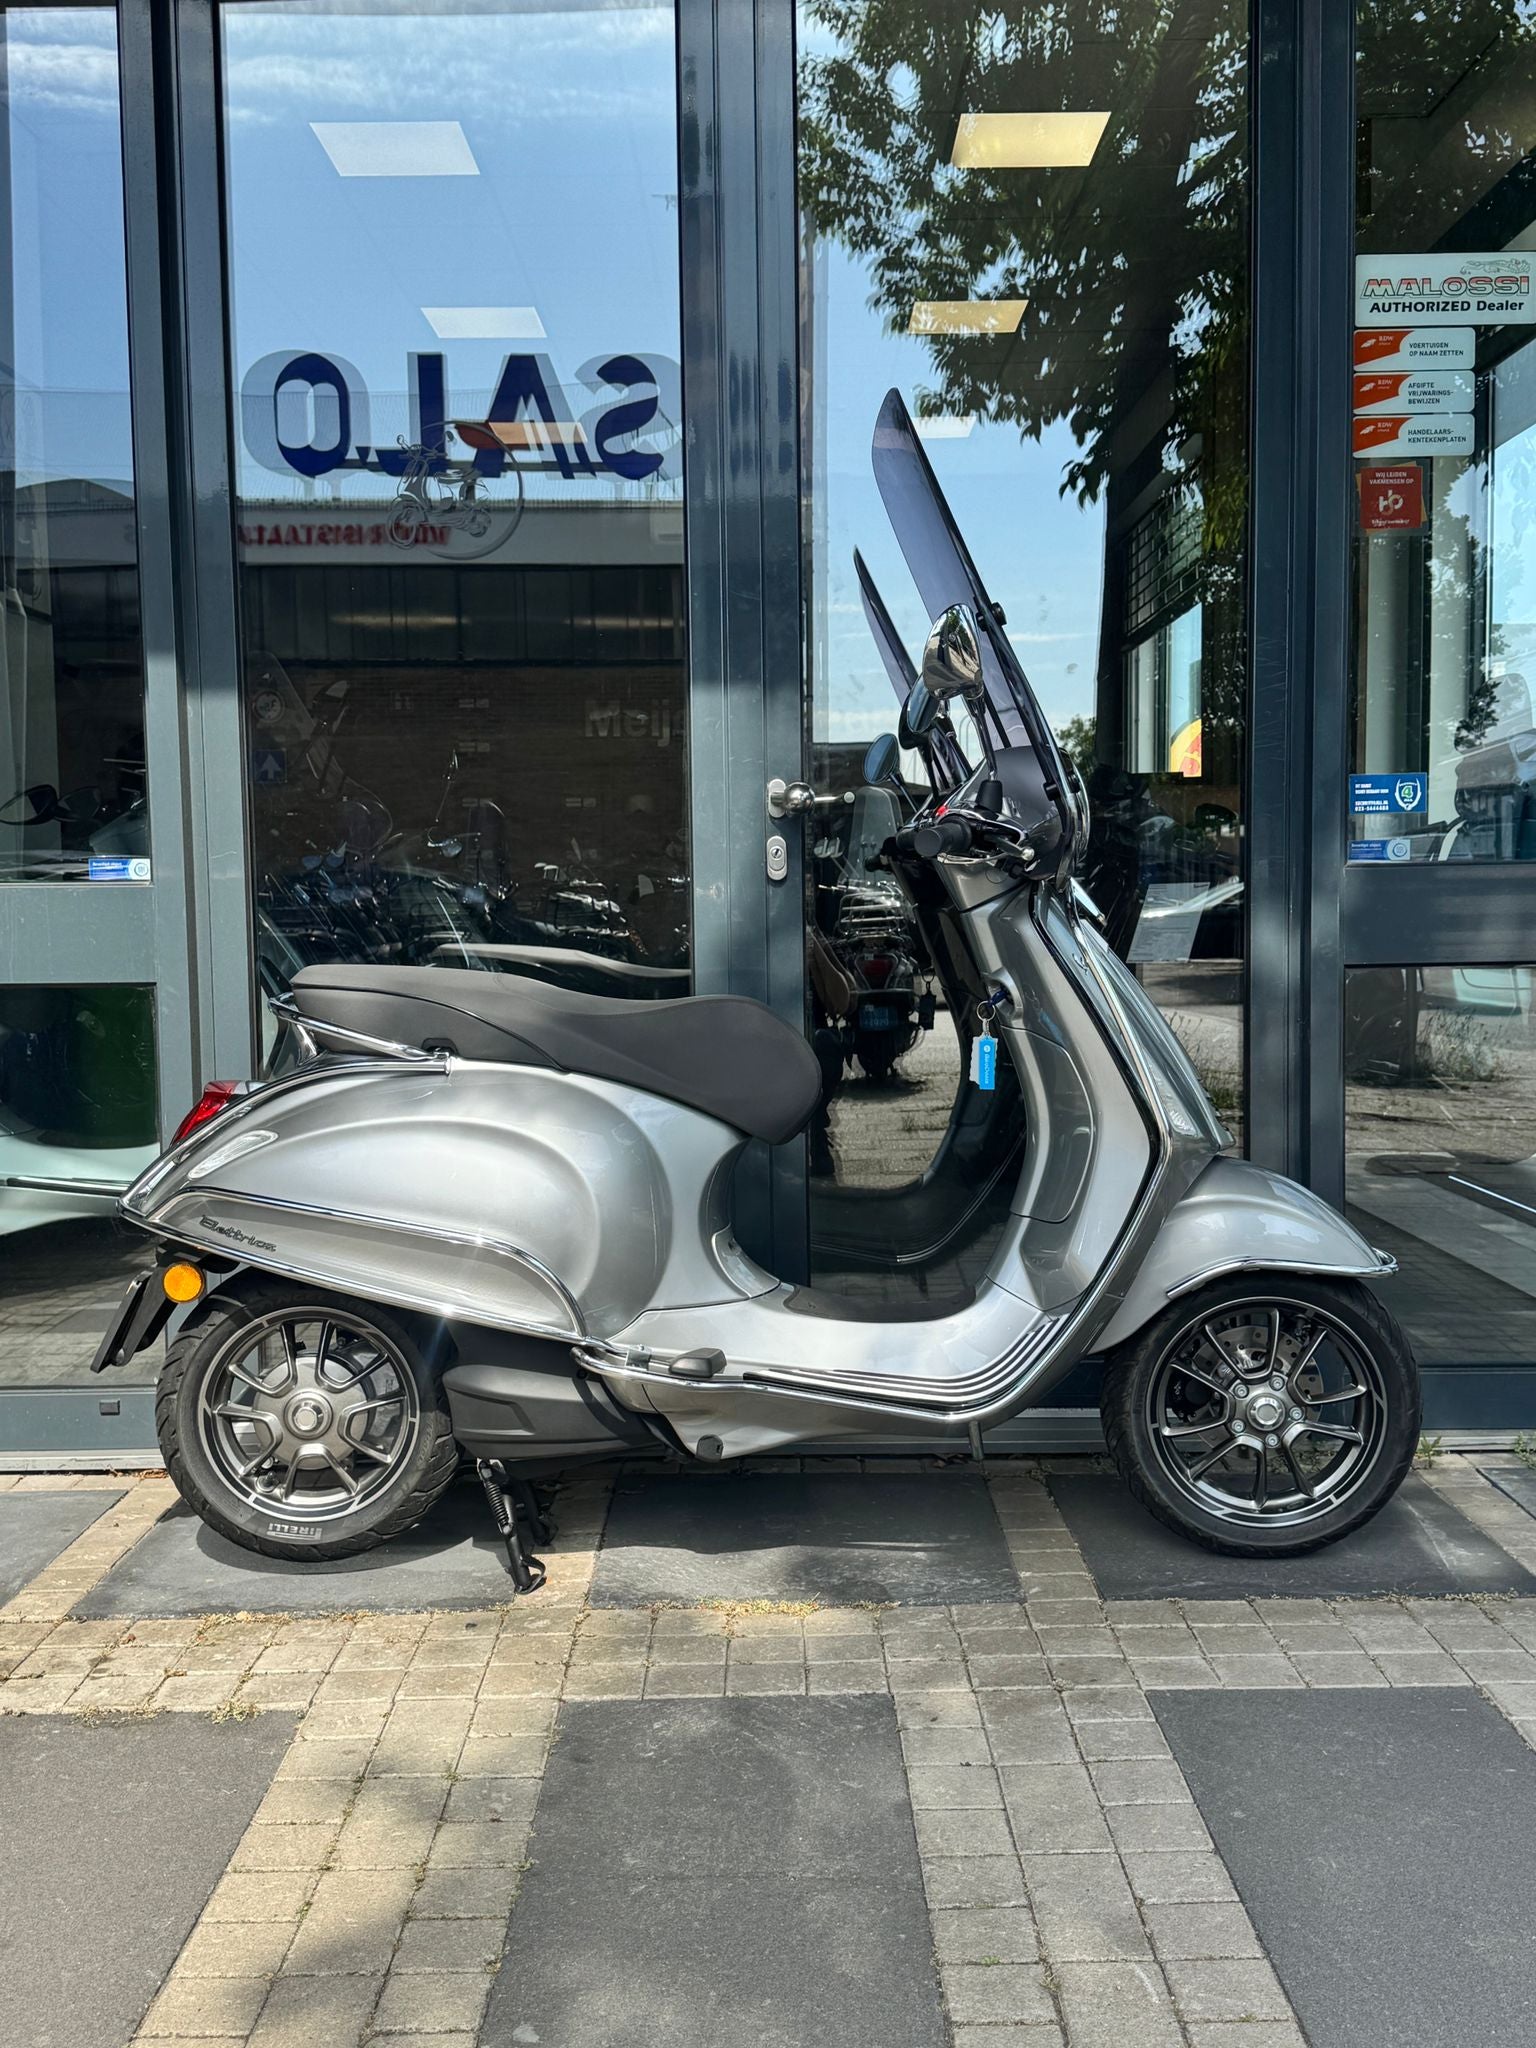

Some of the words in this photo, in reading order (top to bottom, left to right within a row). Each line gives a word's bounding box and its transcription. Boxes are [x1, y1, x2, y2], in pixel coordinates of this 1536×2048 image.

[1360, 276, 1530, 299] MALOSSI
[1369, 301, 1471, 313] AUTHORIZED
[1476, 300, 1525, 311] Dealer
[267, 1523, 323, 1540] PIRELLI
